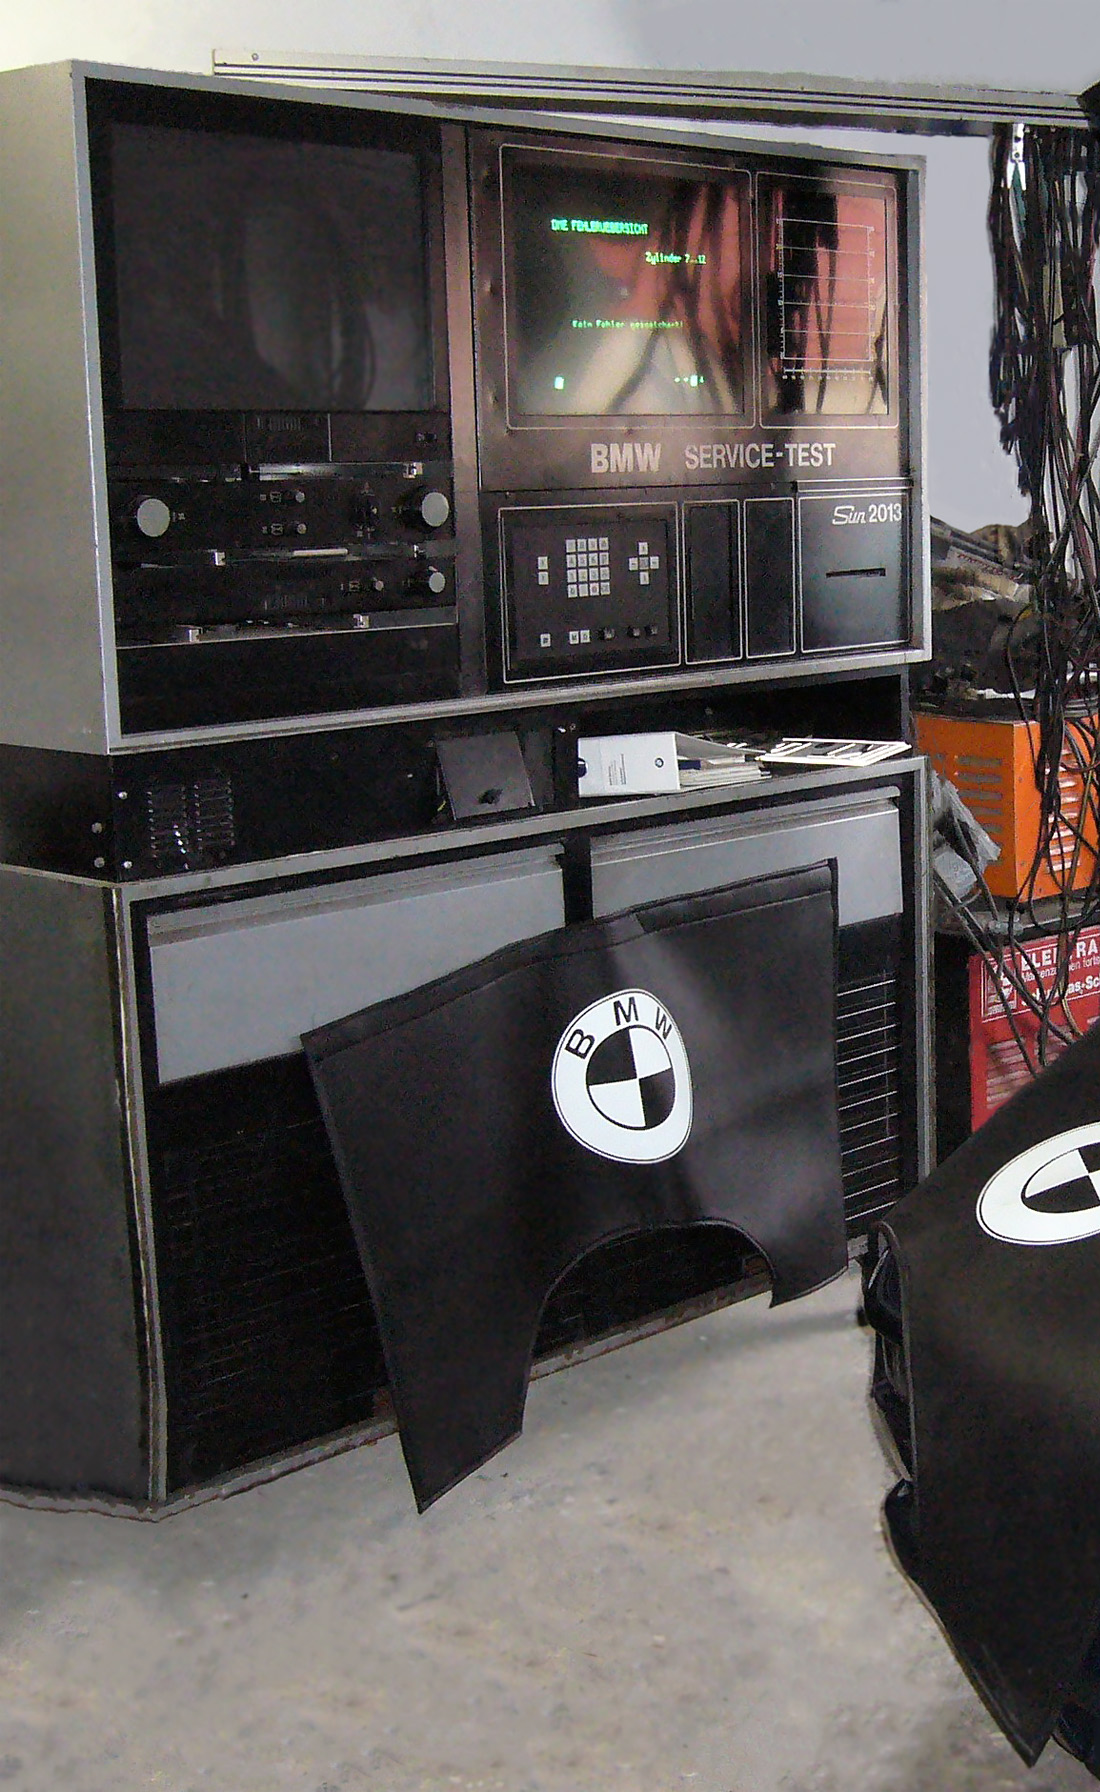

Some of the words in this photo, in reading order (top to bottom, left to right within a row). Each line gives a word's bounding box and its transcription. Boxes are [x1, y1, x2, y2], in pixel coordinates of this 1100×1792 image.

[645, 251, 682, 265] Zylinder
[590, 443, 661, 474] BMW
[684, 443, 836, 469] SERVICE-TEST
[832, 505, 866, 525] Sun
[868, 502, 902, 523] 2013
[564, 996, 673, 1060] BMW
